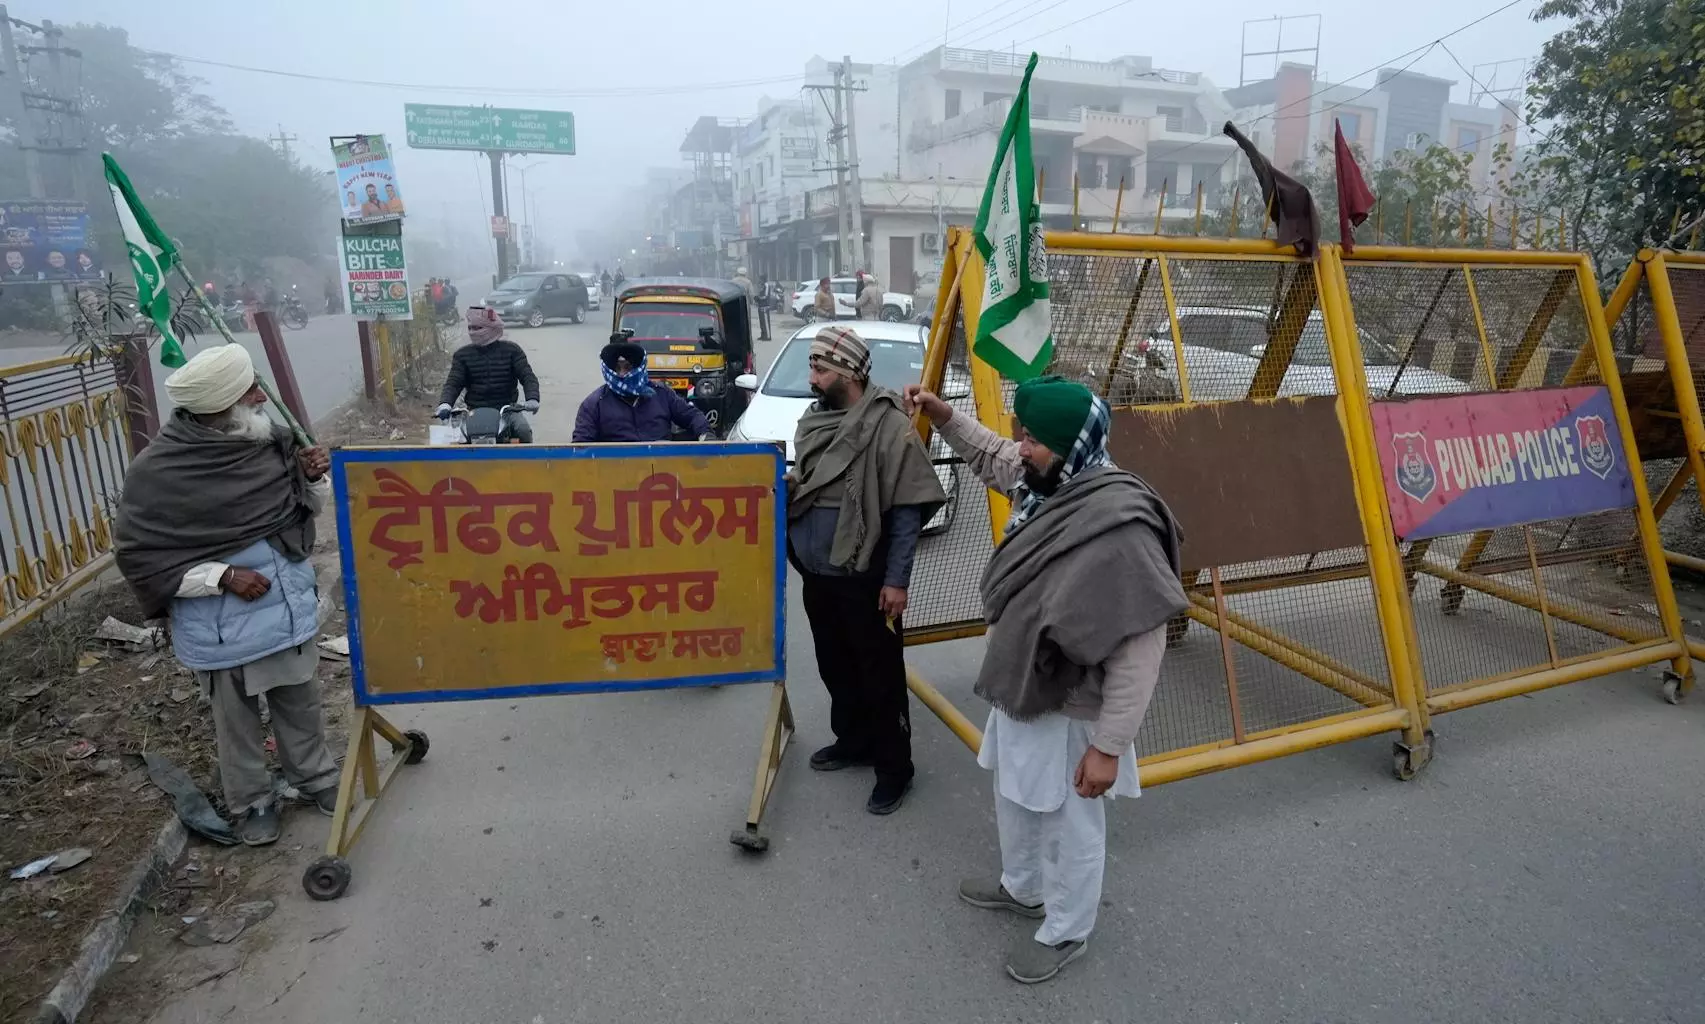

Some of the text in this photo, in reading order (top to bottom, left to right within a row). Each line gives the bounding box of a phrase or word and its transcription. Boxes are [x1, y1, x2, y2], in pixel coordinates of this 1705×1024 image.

[346, 238, 400, 253] KULCHA
[348, 253, 386, 270] BITE
[384, 270, 404, 280] DAIRY
[1434, 427, 1581, 491] PUNJAB POLICE
[368, 467, 768, 569] ਟ੍ਰੈਫਿਕ ਪੁਲਿਸ
[671, 627, 745, 660] ਸਦਰ
